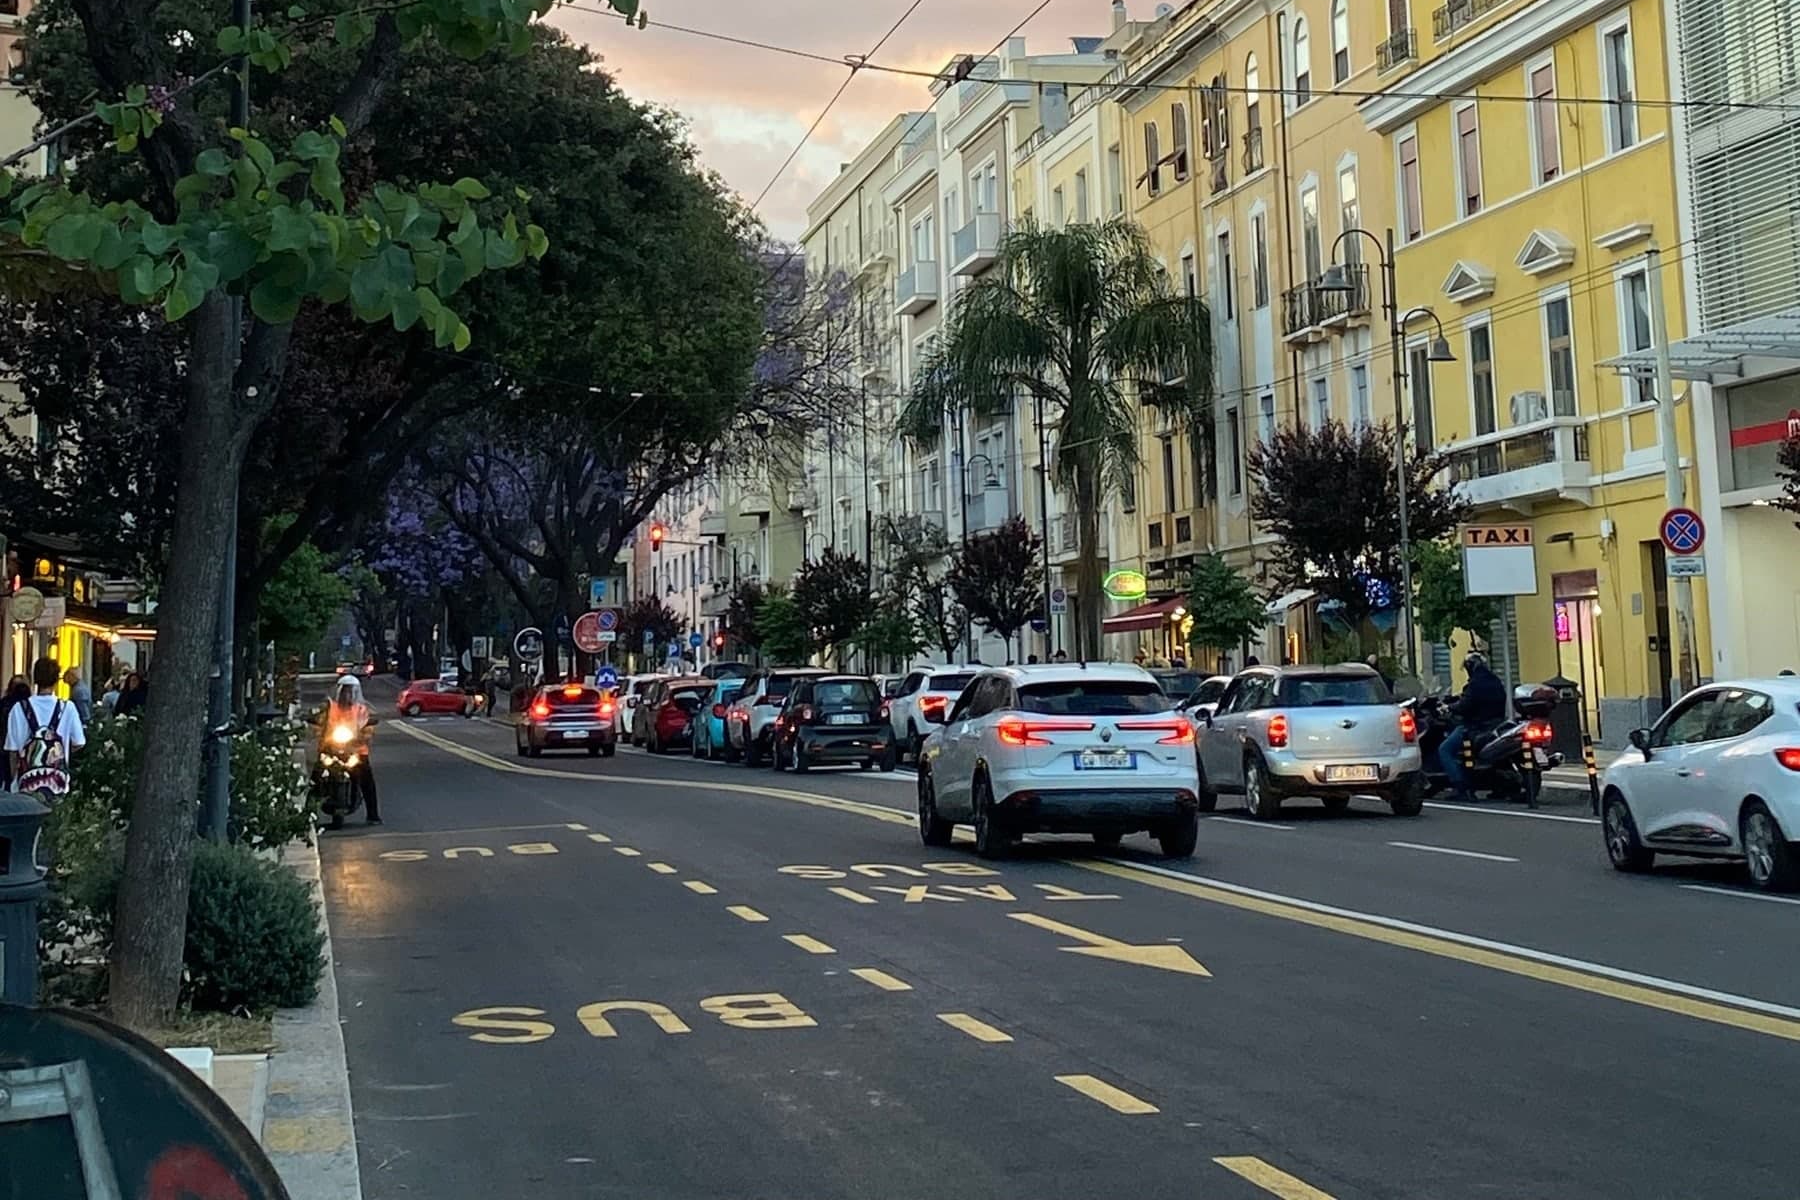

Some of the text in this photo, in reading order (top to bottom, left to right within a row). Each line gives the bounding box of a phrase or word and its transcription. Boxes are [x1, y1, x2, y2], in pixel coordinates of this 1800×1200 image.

[1467, 528, 1530, 544] TAXI
[668, 644, 678, 656] P
[378, 842, 559, 862] BUS
[777, 862, 1002, 879] BUS
[827, 883, 1122, 903] TAXI
[451, 992, 818, 1044] BUS
